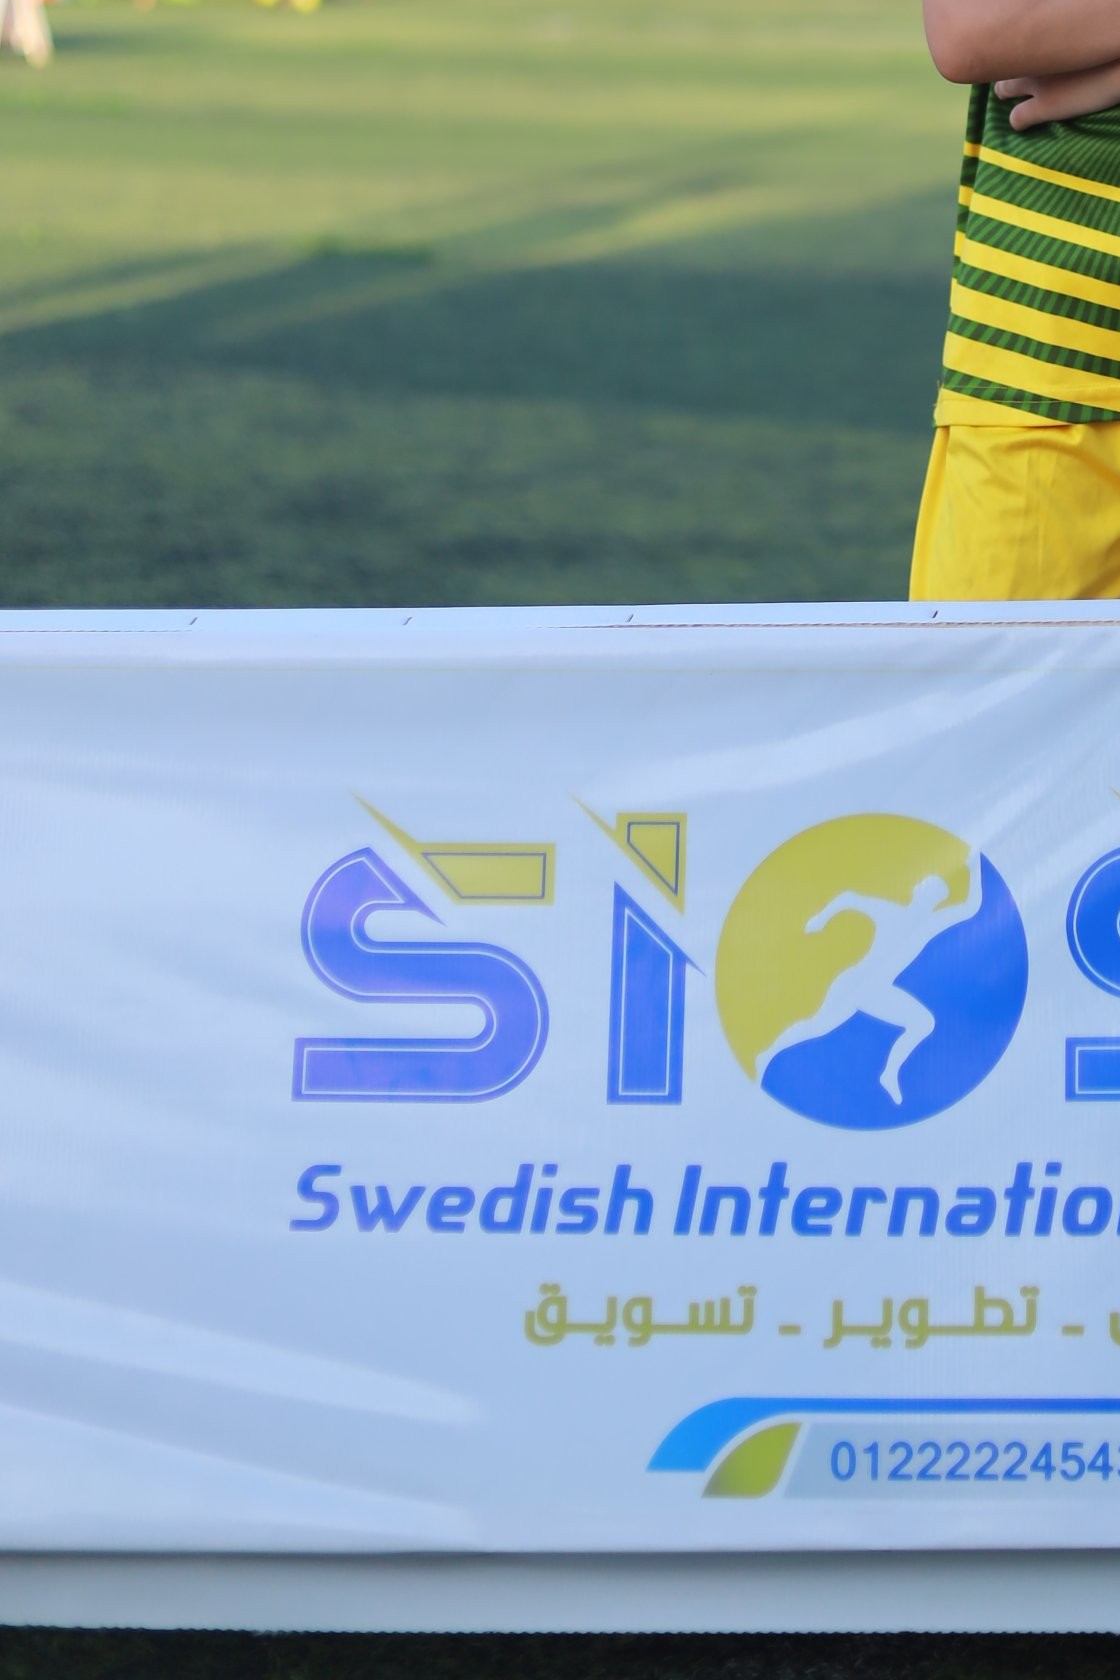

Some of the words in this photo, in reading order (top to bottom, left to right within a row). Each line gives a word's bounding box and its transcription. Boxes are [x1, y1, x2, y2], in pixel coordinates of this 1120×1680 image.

[289, 1162, 654, 1236] Swedish
[523, 1282, 757, 1347] تسويق
[823, 1285, 1040, 1349] تطوير
